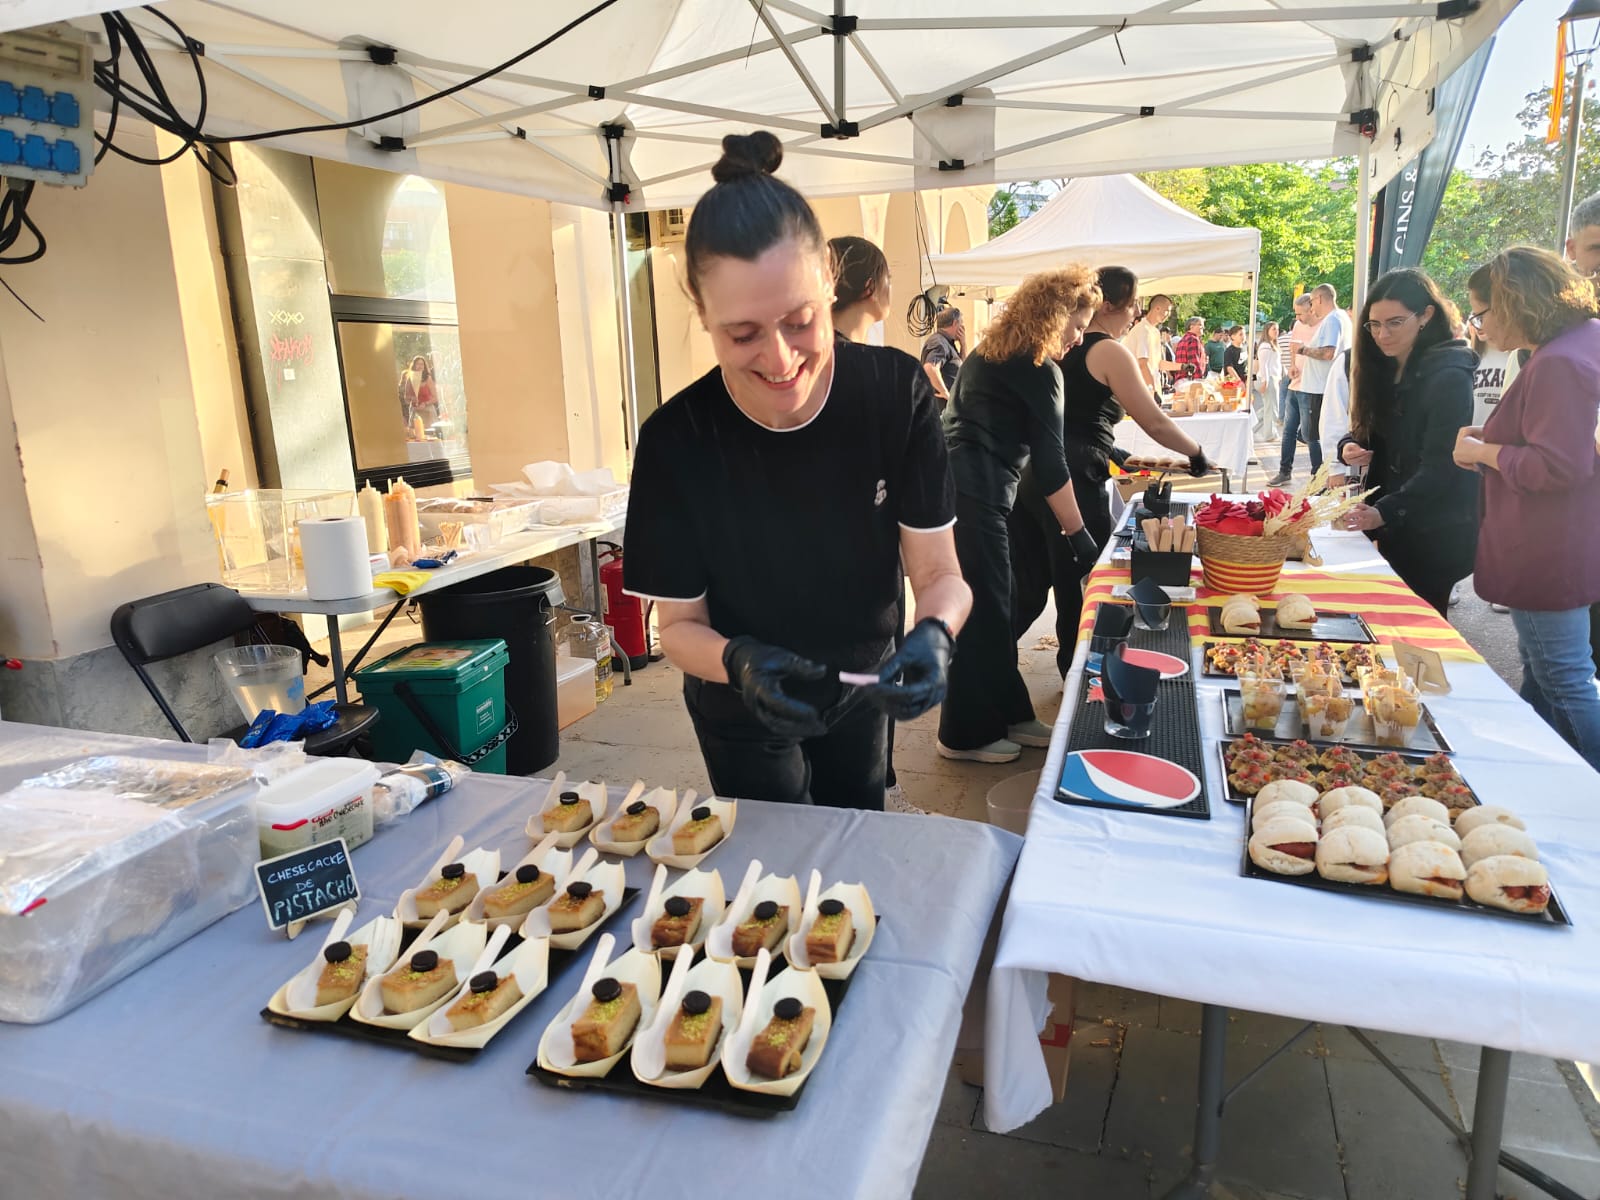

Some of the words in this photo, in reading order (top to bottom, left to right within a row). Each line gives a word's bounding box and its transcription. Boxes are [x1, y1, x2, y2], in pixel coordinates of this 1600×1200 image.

[1473, 368, 1506, 390] EXA
[267, 851, 346, 884] CHESECACKE
[273, 873, 355, 921] PISTACHO
[295, 878, 315, 892] DE
